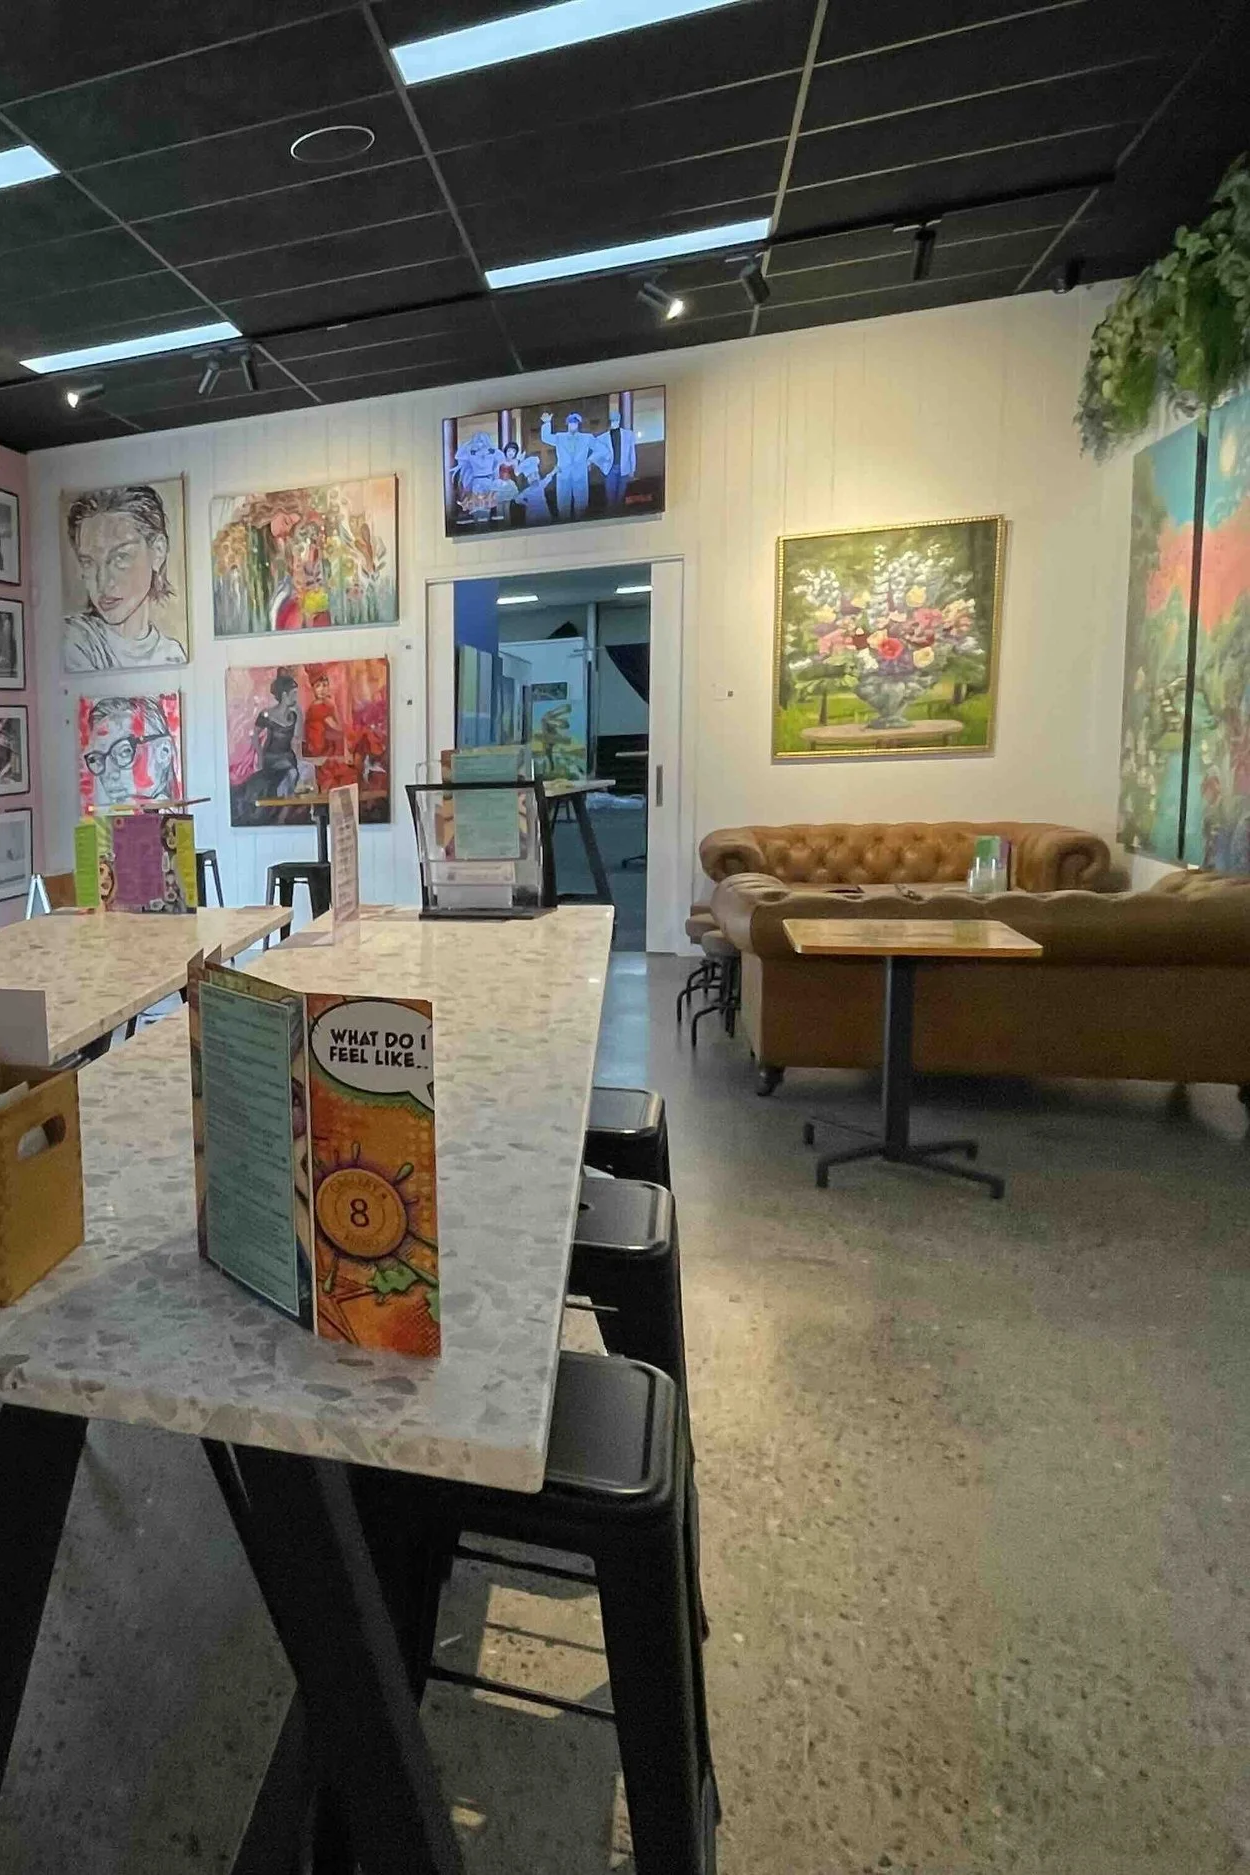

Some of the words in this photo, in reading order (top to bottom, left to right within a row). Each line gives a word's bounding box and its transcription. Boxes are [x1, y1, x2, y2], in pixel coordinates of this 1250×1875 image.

[330, 1028, 378, 1046] WHAT
[385, 1032, 414, 1049] DO
[421, 1034, 426, 1050] I
[330, 1046, 368, 1064] FEEL
[350, 1198, 369, 1227] 8
